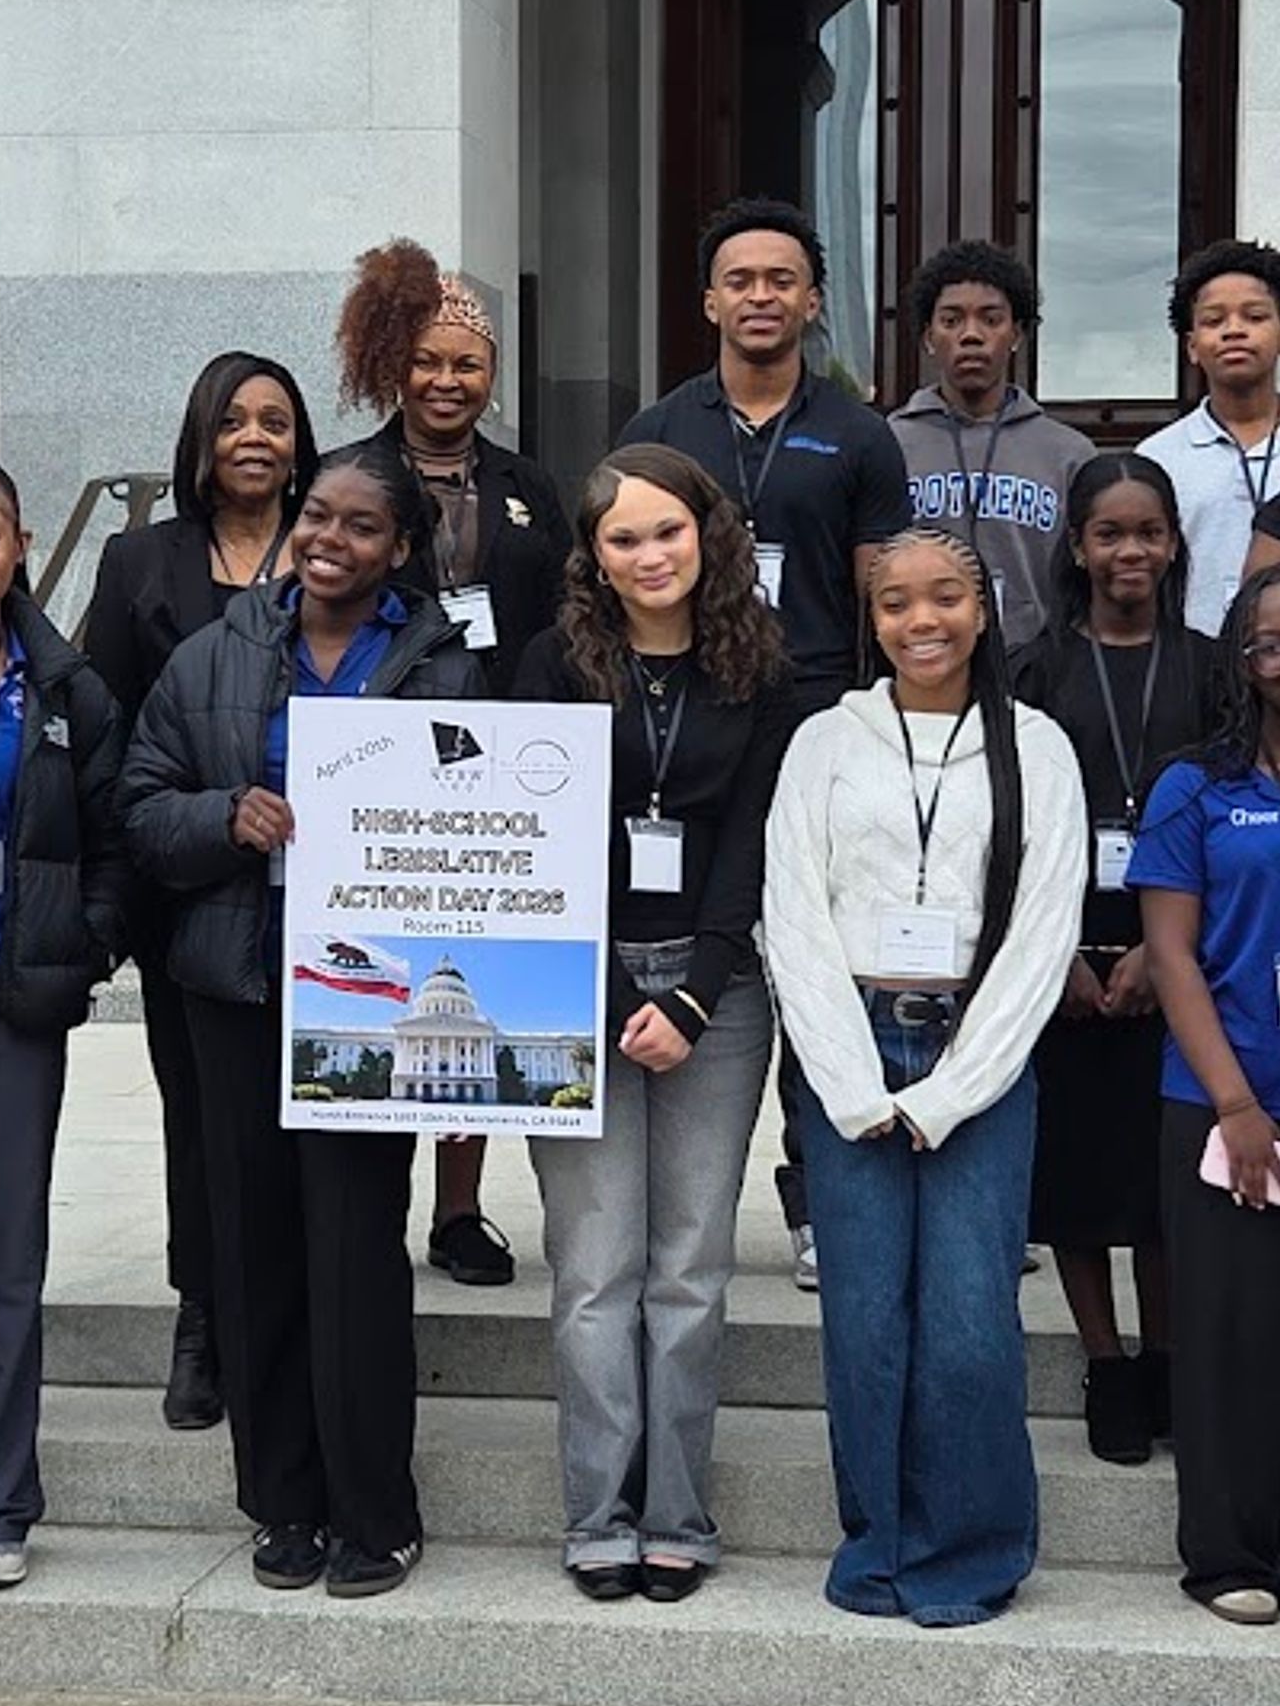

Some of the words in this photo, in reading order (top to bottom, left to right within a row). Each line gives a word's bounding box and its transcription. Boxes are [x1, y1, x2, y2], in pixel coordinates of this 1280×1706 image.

[316, 753, 354, 780] April
[355, 734, 395, 761] 20th
[352, 808, 546, 837] HIGH-SCHOOL
[1230, 808, 1279, 826] Cheer
[364, 846, 533, 875] LEGISLATIVE
[327, 884, 432, 911] ACTION
[438, 886, 494, 913] DAY
[496, 888, 566, 915] 2026
[403, 917, 452, 934] Room
[456, 919, 484, 935] 115
